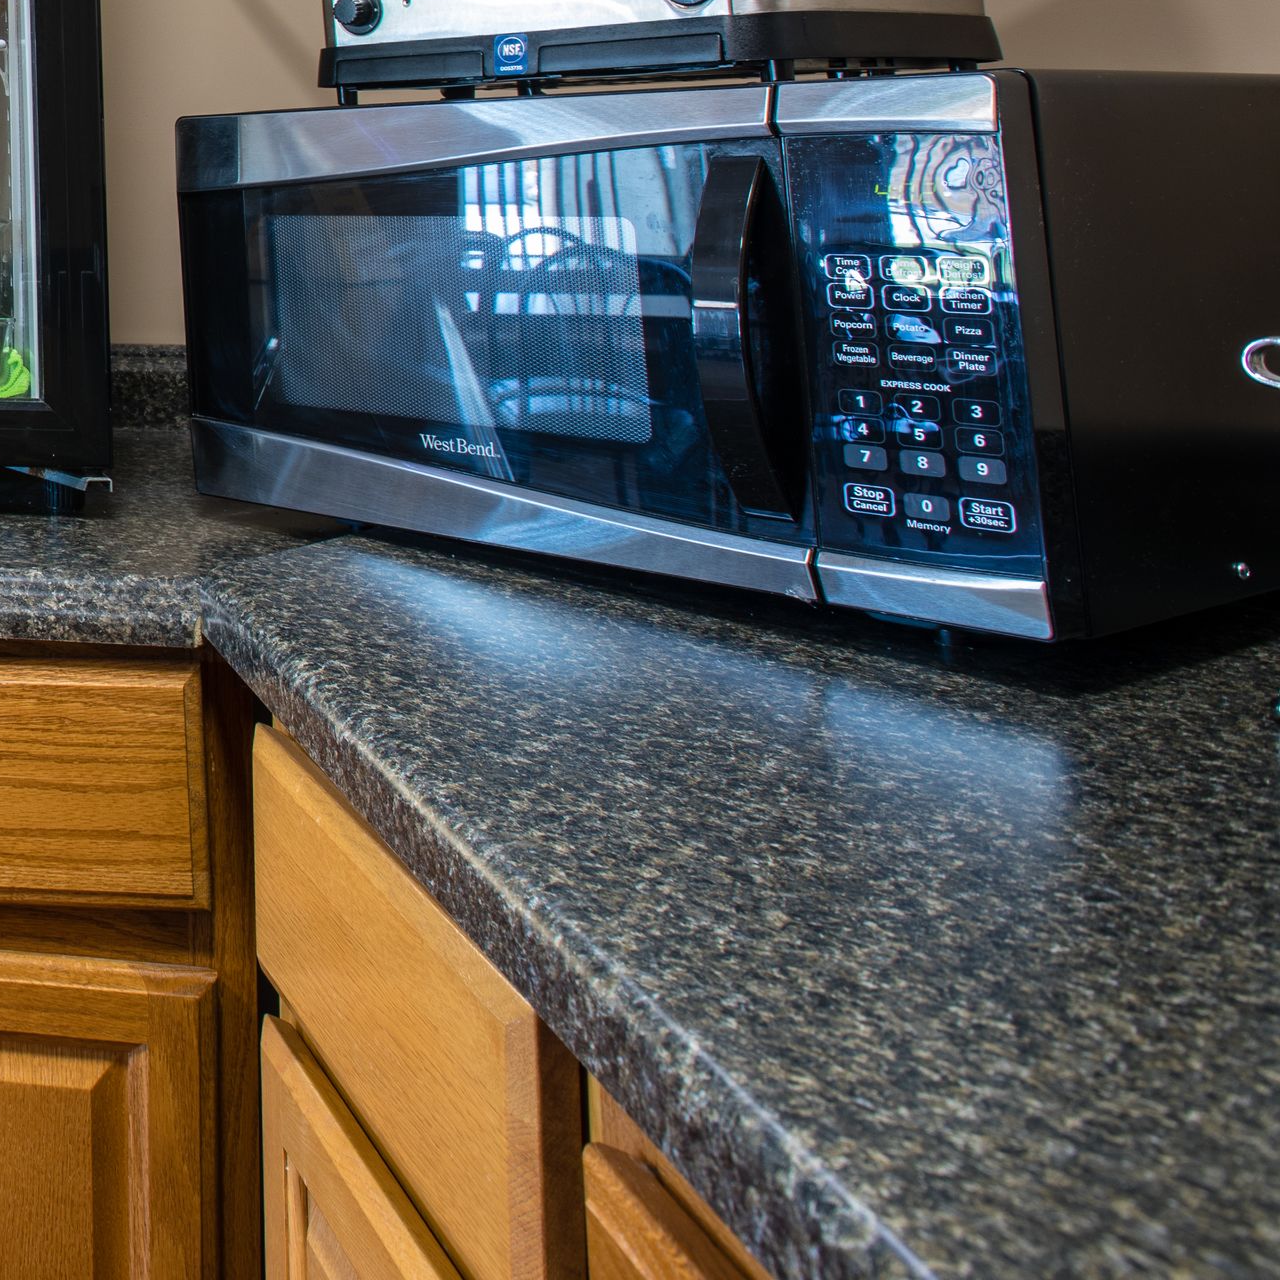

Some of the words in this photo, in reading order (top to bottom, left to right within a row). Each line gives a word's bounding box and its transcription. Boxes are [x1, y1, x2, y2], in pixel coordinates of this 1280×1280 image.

[502, 43, 521, 57] NSF
[834, 257, 860, 266] Time
[942, 260, 981, 272] Weight
[944, 270, 983, 280] Defrost
[834, 291, 866, 300] Power
[893, 293, 920, 303] Clock
[946, 291, 985, 301] Kitchen
[950, 300, 983, 310] Timer
[834, 320, 873, 331] Popcorn
[893, 323, 925, 332] Potato
[955, 325, 982, 335] Pizza
[842, 344, 869, 354] Frozen
[836, 353, 877, 365] Vegetable
[891, 352, 934, 364] Beverage
[953, 351, 990, 362] Dinner
[958, 361, 986, 371] Plate
[880, 379, 922, 390] EXPRESS
[923, 383, 952, 393] COOK
[855, 395, 865, 408] 1
[911, 400, 923, 413] 2
[970, 405, 982, 418] 3
[857, 422, 868, 435] 4
[914, 428, 925, 441] 5
[419, 433, 455, 453] West
[456, 437, 496, 458] Bend
[973, 433, 986, 447] 6
[859, 450, 871, 463] 7
[916, 456, 929, 469] 8
[976, 462, 989, 476] 9
[853, 486, 885, 501] Stop
[852, 500, 887, 513] Cancel
[921, 499, 932, 513] 0
[971, 502, 1004, 517] Start
[906, 519, 952, 535] Memory
[968, 515, 1008, 528] +30sec.
